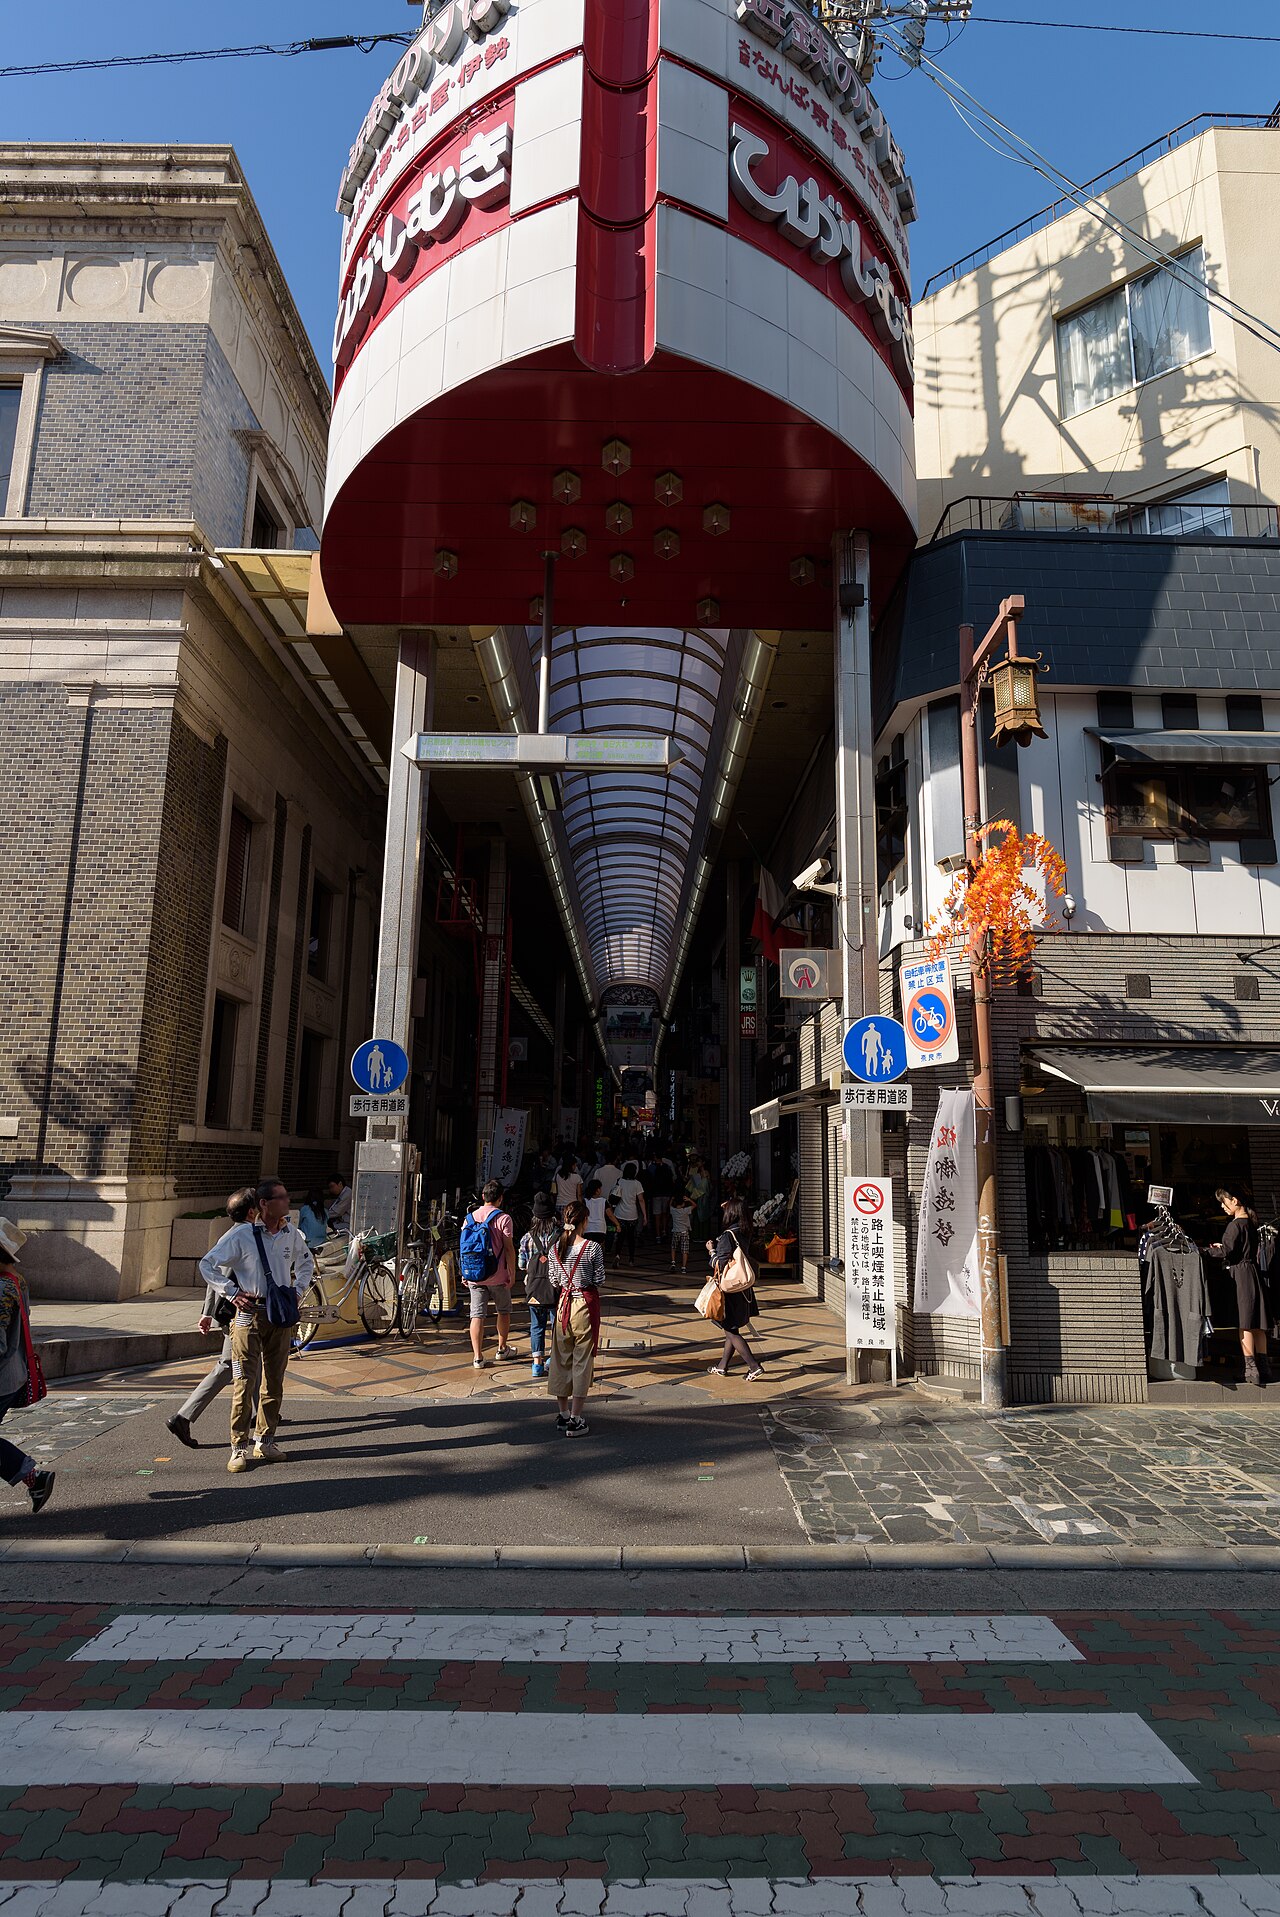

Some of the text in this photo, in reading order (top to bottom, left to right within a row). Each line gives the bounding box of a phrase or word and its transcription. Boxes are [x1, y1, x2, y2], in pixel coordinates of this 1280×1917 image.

[332, 124, 513, 364] ひがしむき
[731, 121, 914, 386] ひがしむき
[908, 973, 945, 990] 禁止区域
[741, 1016, 756, 1030] JRS
[920, 1052, 943, 1063] 奈良市
[845, 1088, 908, 1104] 歩行者用道路
[353, 1098, 406, 1112] 歩行者用道路
[850, 1217, 860, 1289] 禁止されています。
[871, 1218, 887, 1331] 路上喫煙禁止地域
[857, 1338, 885, 1346] 奈良市
